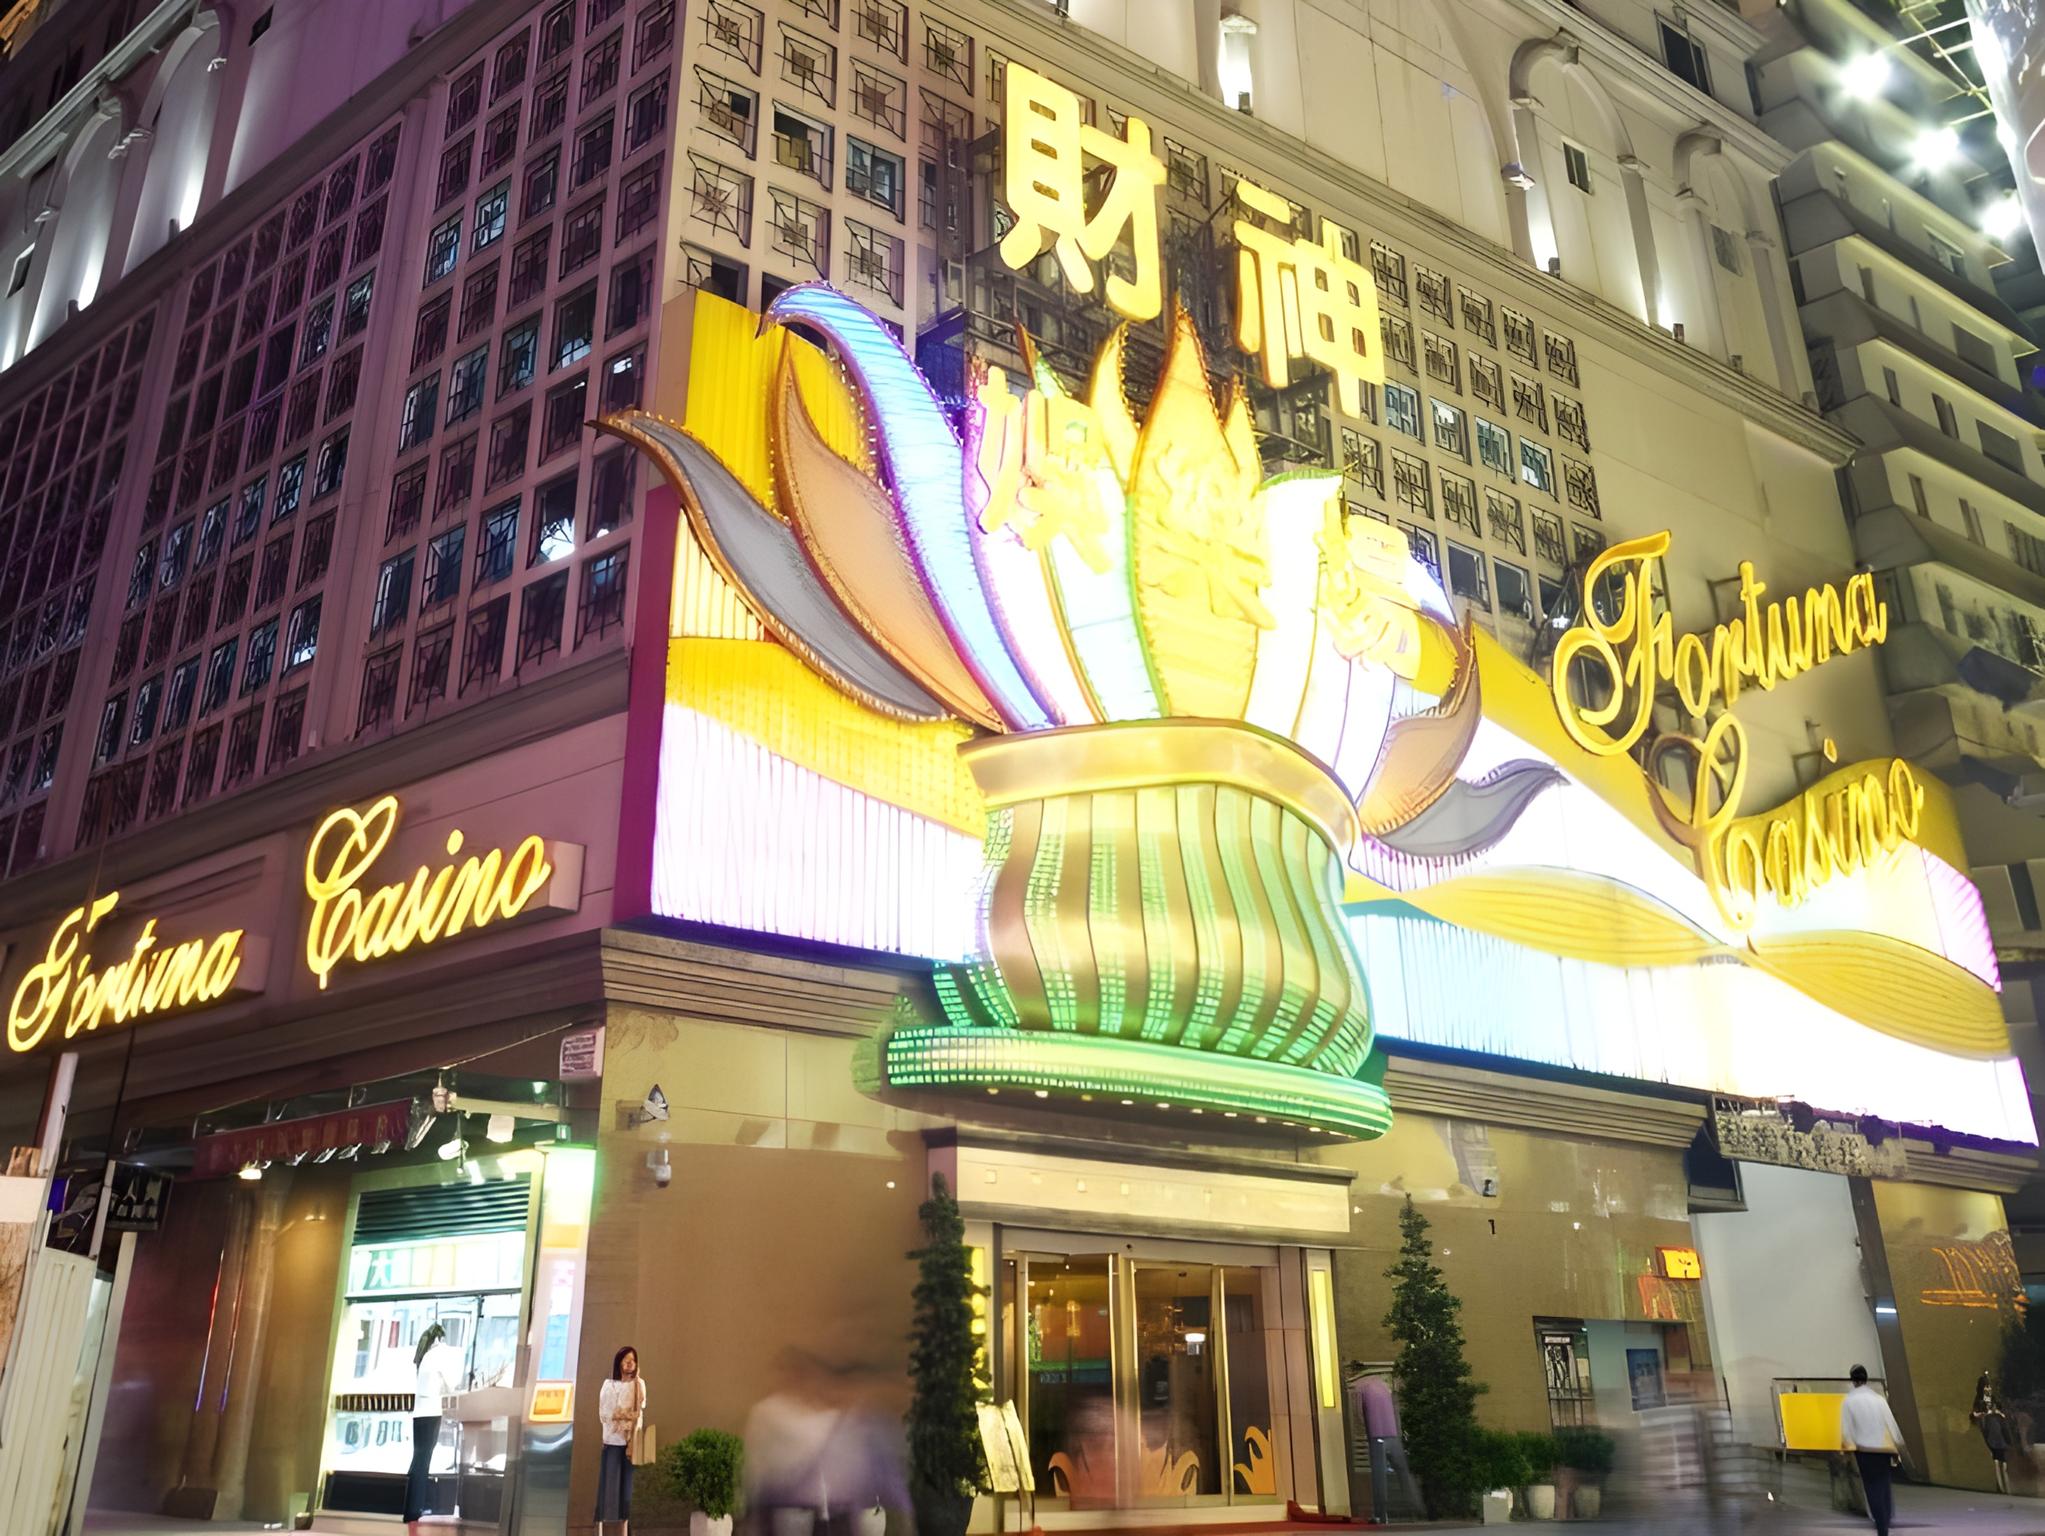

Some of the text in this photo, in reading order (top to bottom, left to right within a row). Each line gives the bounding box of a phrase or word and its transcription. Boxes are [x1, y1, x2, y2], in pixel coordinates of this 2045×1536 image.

[1000, 63, 1386, 419] 財神
[1552, 530, 1888, 757] Fortuna
[7, 795, 552, 1053] Fortuna Casino
[1646, 713, 1925, 930] Casino
